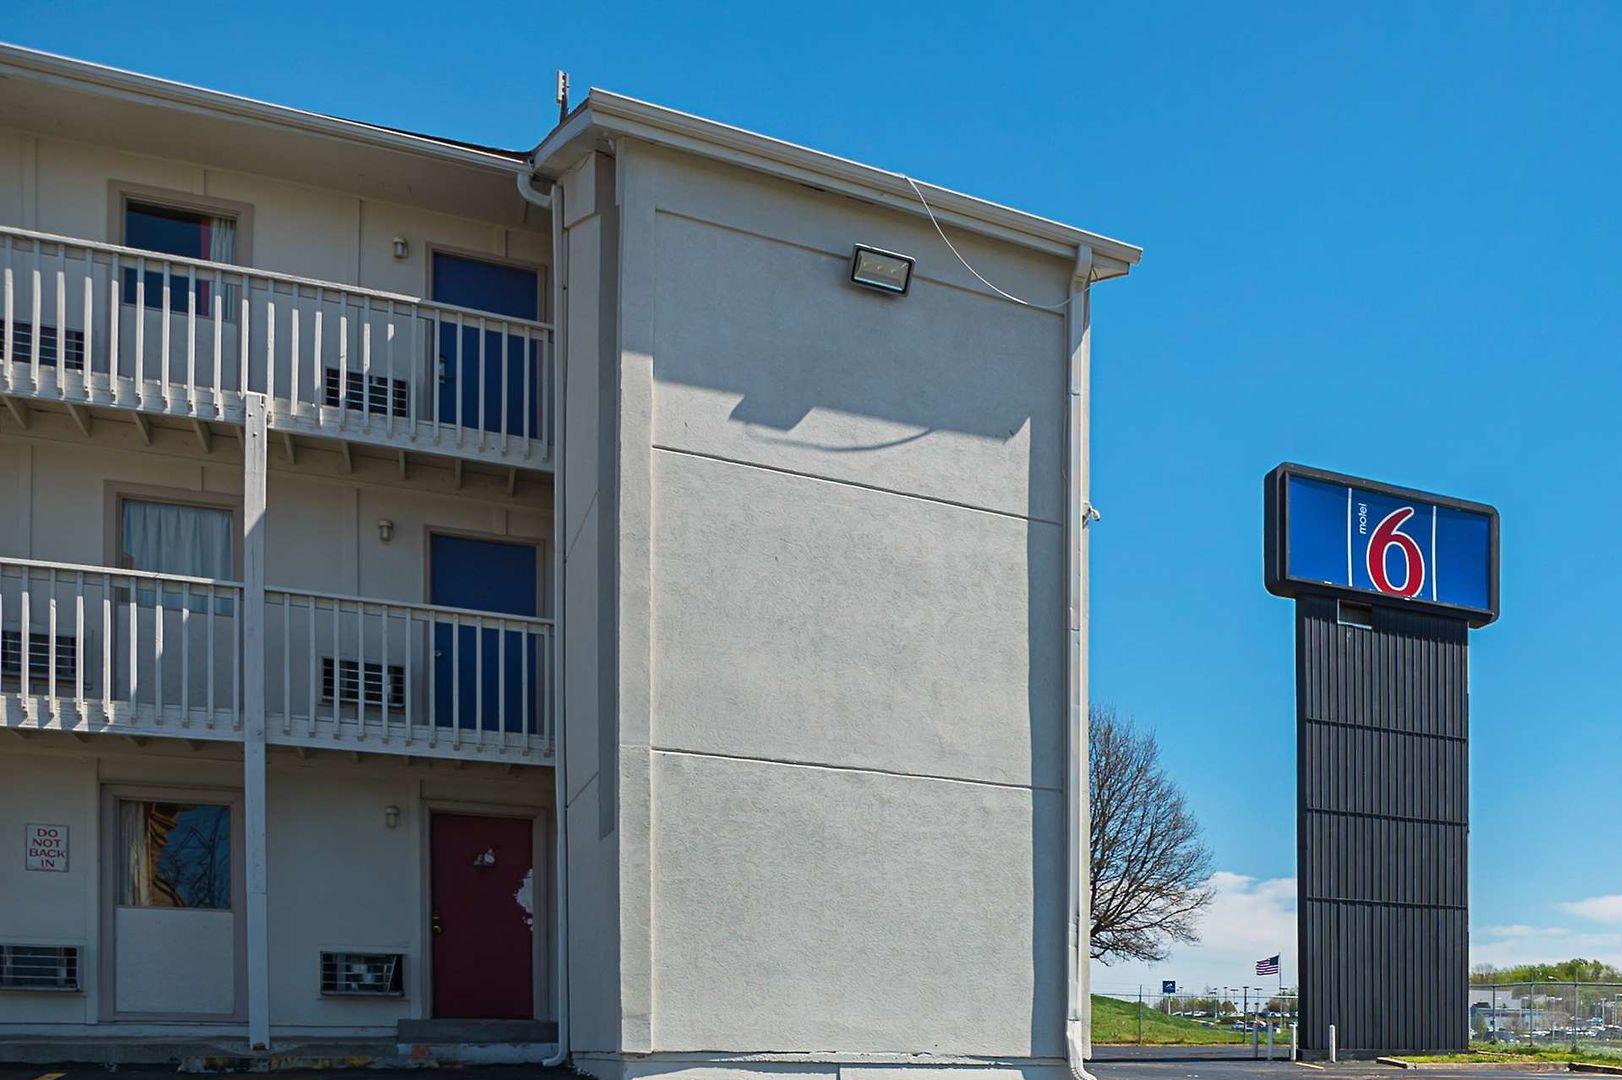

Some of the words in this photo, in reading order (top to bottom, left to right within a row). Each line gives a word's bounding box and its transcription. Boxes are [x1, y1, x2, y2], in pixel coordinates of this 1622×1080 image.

[1358, 502, 1368, 535] motel
[1366, 506, 1425, 598] 6
[37, 828, 58, 838] DO
[32, 838, 62, 848] NOT
[29, 848, 66, 858] BACK
[41, 859, 55, 868] IN
